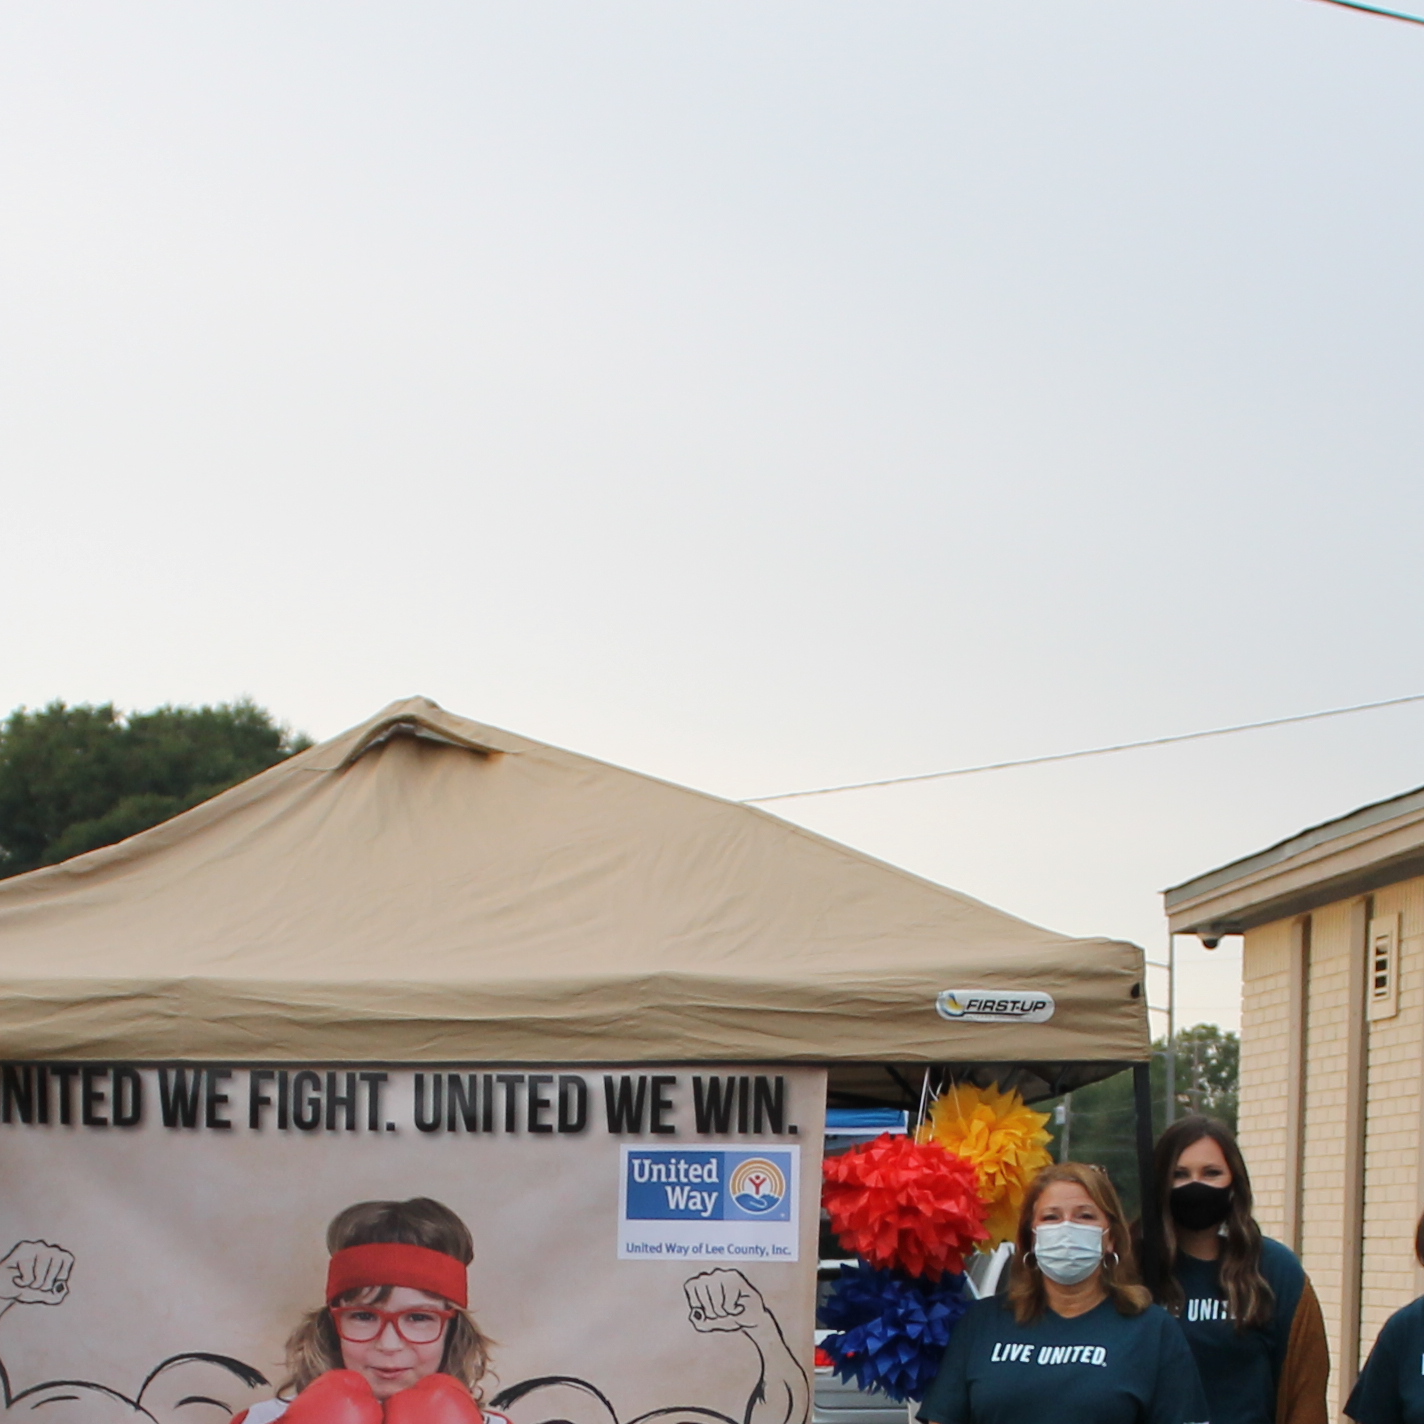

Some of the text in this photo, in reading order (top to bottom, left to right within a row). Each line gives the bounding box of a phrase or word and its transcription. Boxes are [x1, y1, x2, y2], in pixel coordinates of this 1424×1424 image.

[157, 1067, 233, 1129] WE
[249, 1069, 396, 1132] FIGHT.
[413, 1072, 589, 1134] UNITED
[603, 1075, 677, 1135] WE
[692, 1075, 799, 1136] WIN.
[631, 1157, 720, 1184] United
[665, 1185, 719, 1218] Way
[626, 1242, 792, 1258] United Way of Lee County, Inc.
[990, 1342, 1035, 1363] LIVE
